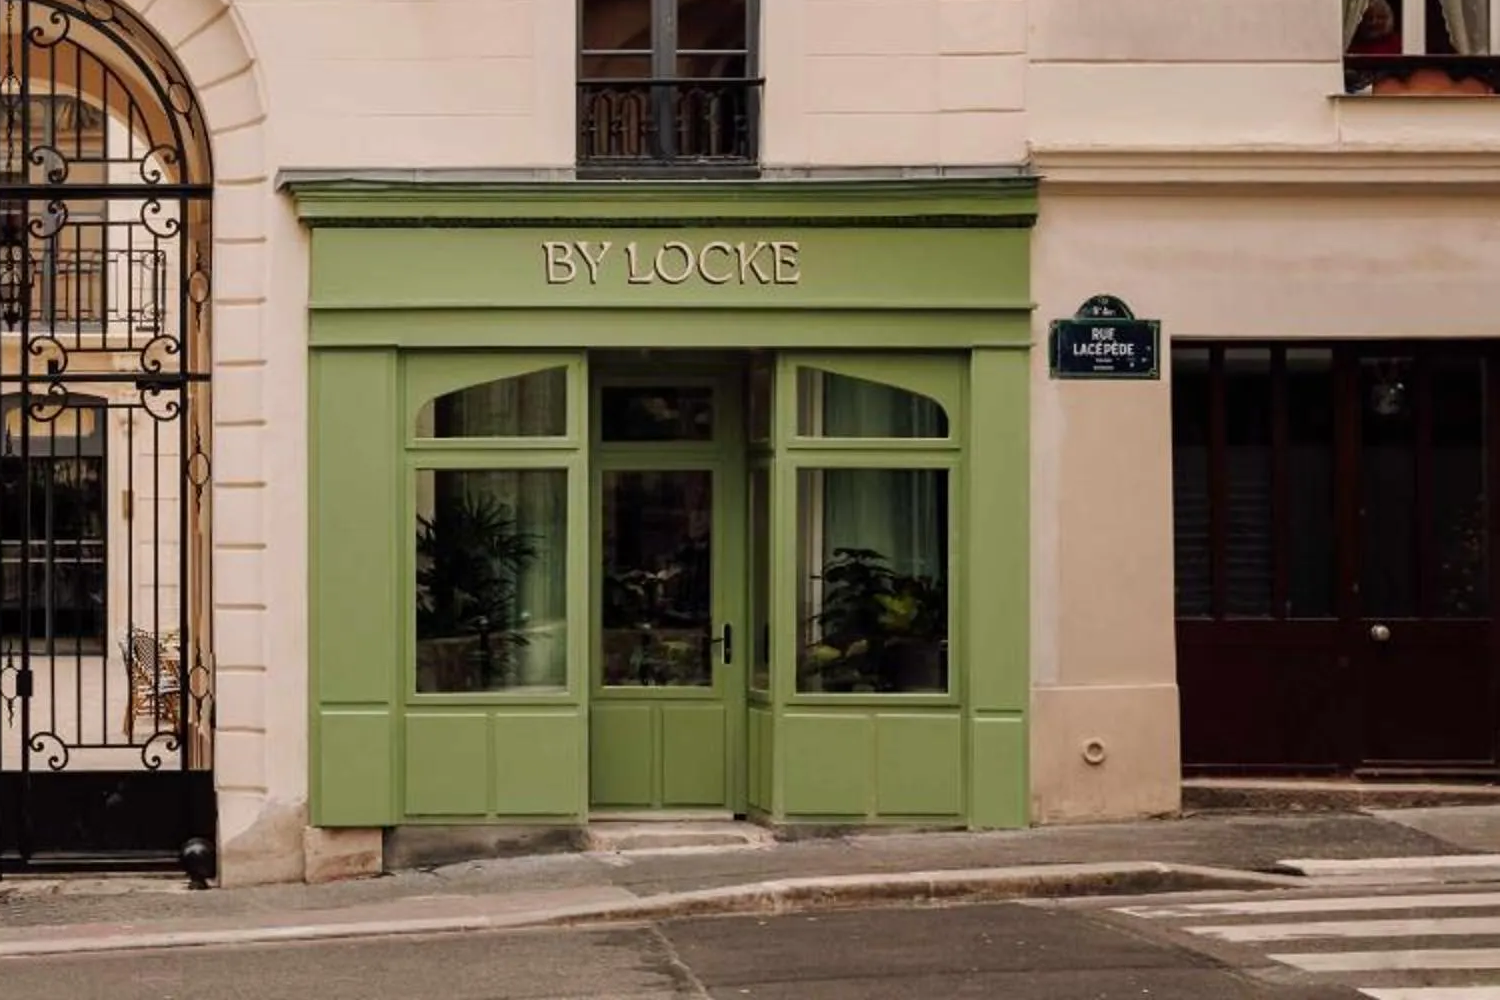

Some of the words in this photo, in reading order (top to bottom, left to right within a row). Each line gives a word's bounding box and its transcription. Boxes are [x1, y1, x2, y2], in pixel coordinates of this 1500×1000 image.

[542, 241, 613, 285] BY
[624, 241, 801, 285] LOCKE
[1092, 328, 1115, 340] RUE
